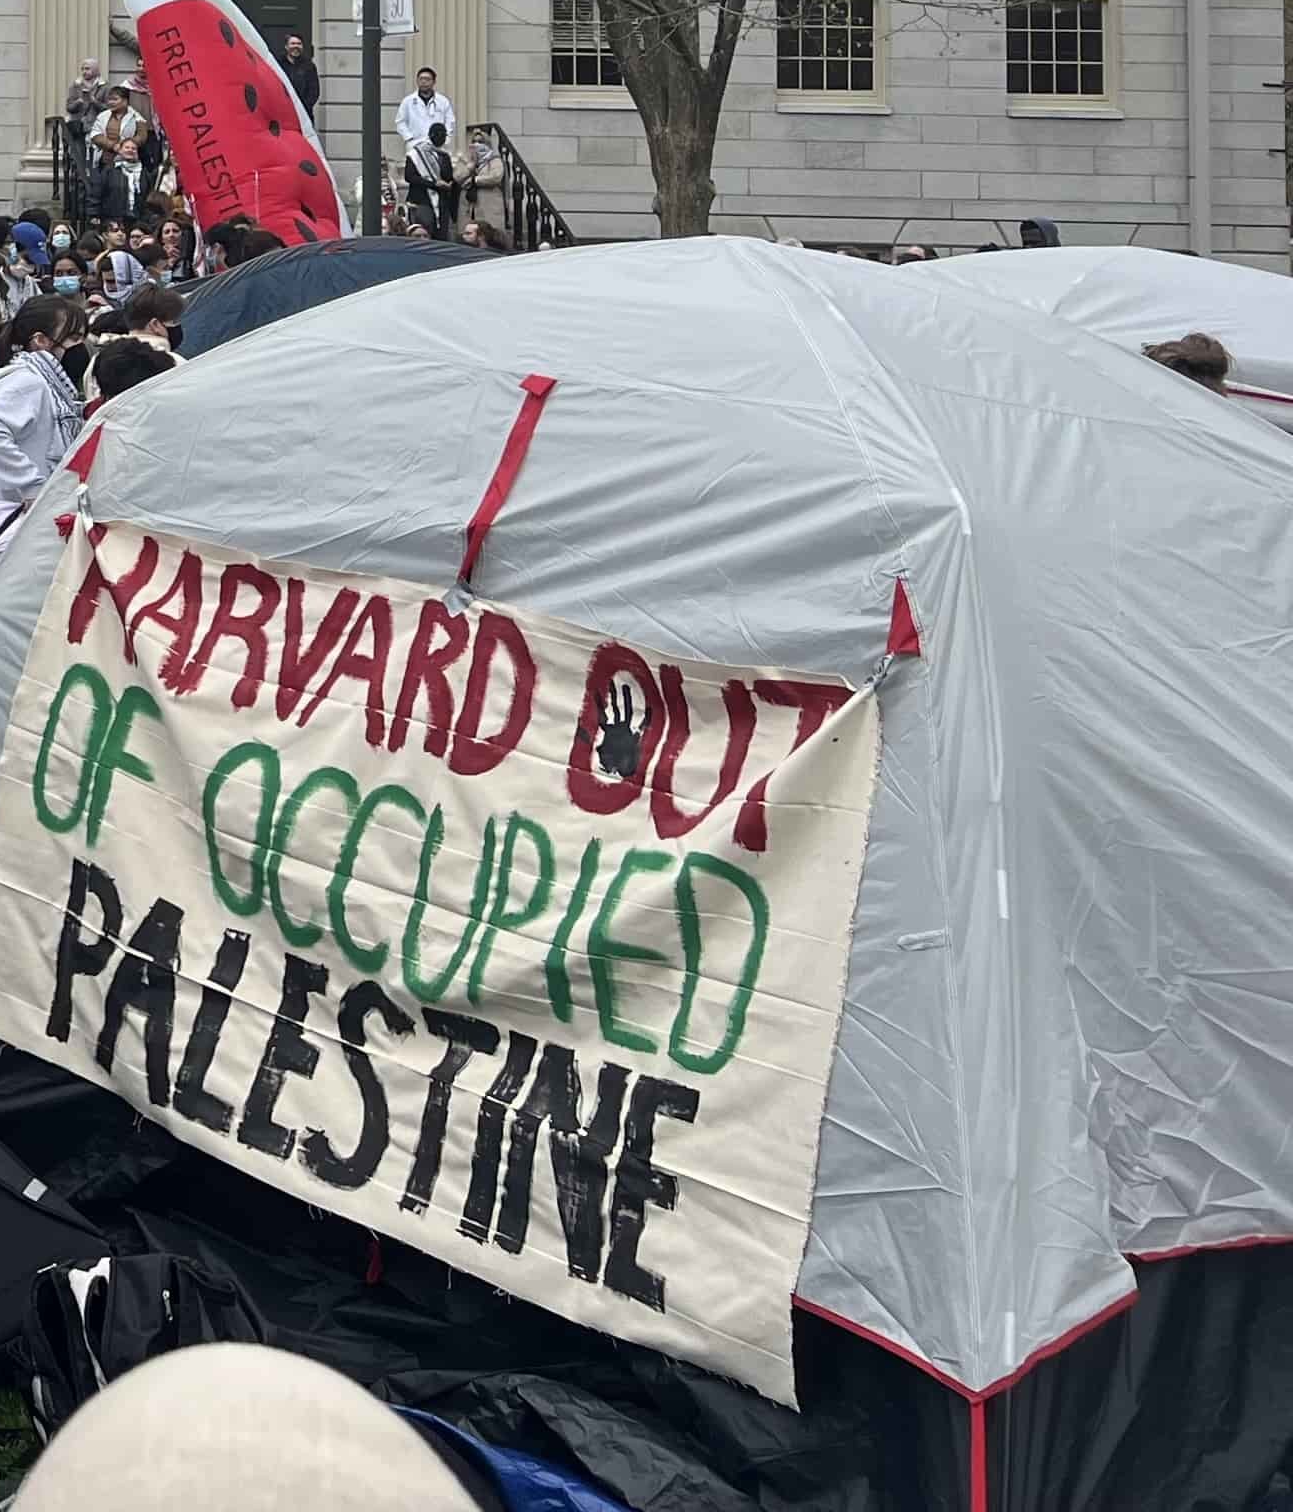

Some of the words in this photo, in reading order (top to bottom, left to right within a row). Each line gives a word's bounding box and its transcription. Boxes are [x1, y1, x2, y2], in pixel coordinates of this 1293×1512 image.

[156, 25, 199, 97] FREE
[181, 101, 243, 216] PALESTI
[33, 663, 163, 847] OF
[201, 740, 769, 1075] OCCUPIED
[66, 522, 538, 776] HARVARD
[566, 640, 855, 852] OUT
[45, 856, 701, 1314] PALESTINE
